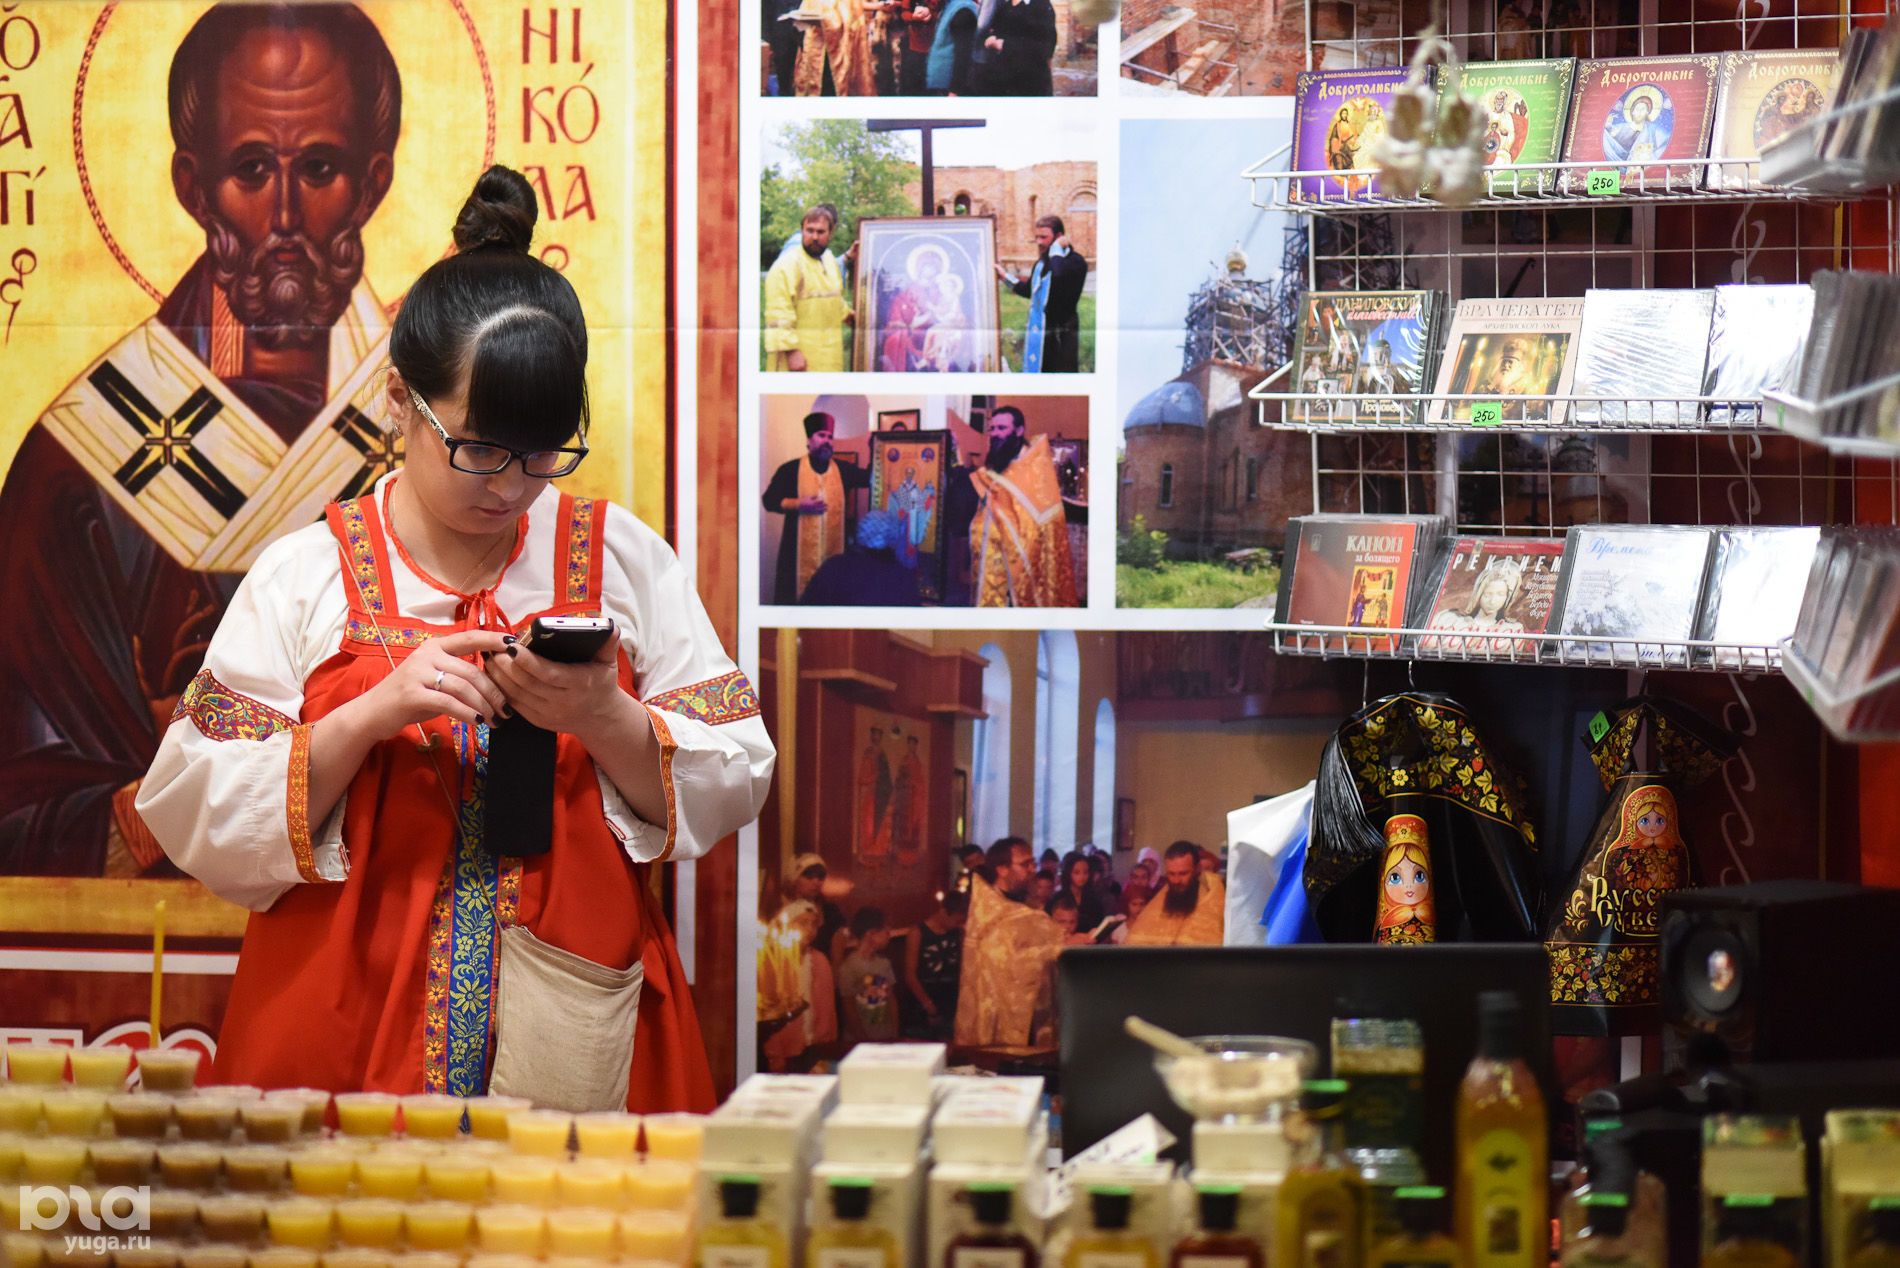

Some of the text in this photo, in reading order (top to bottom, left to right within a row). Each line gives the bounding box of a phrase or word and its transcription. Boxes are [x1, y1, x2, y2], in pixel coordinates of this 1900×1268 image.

[1592, 176, 1614, 191] 250
[1473, 410, 1496, 422] 250
[1345, 535, 1404, 553] КАНОН
[1451, 552, 1563, 573] РЕКВИЕМ
